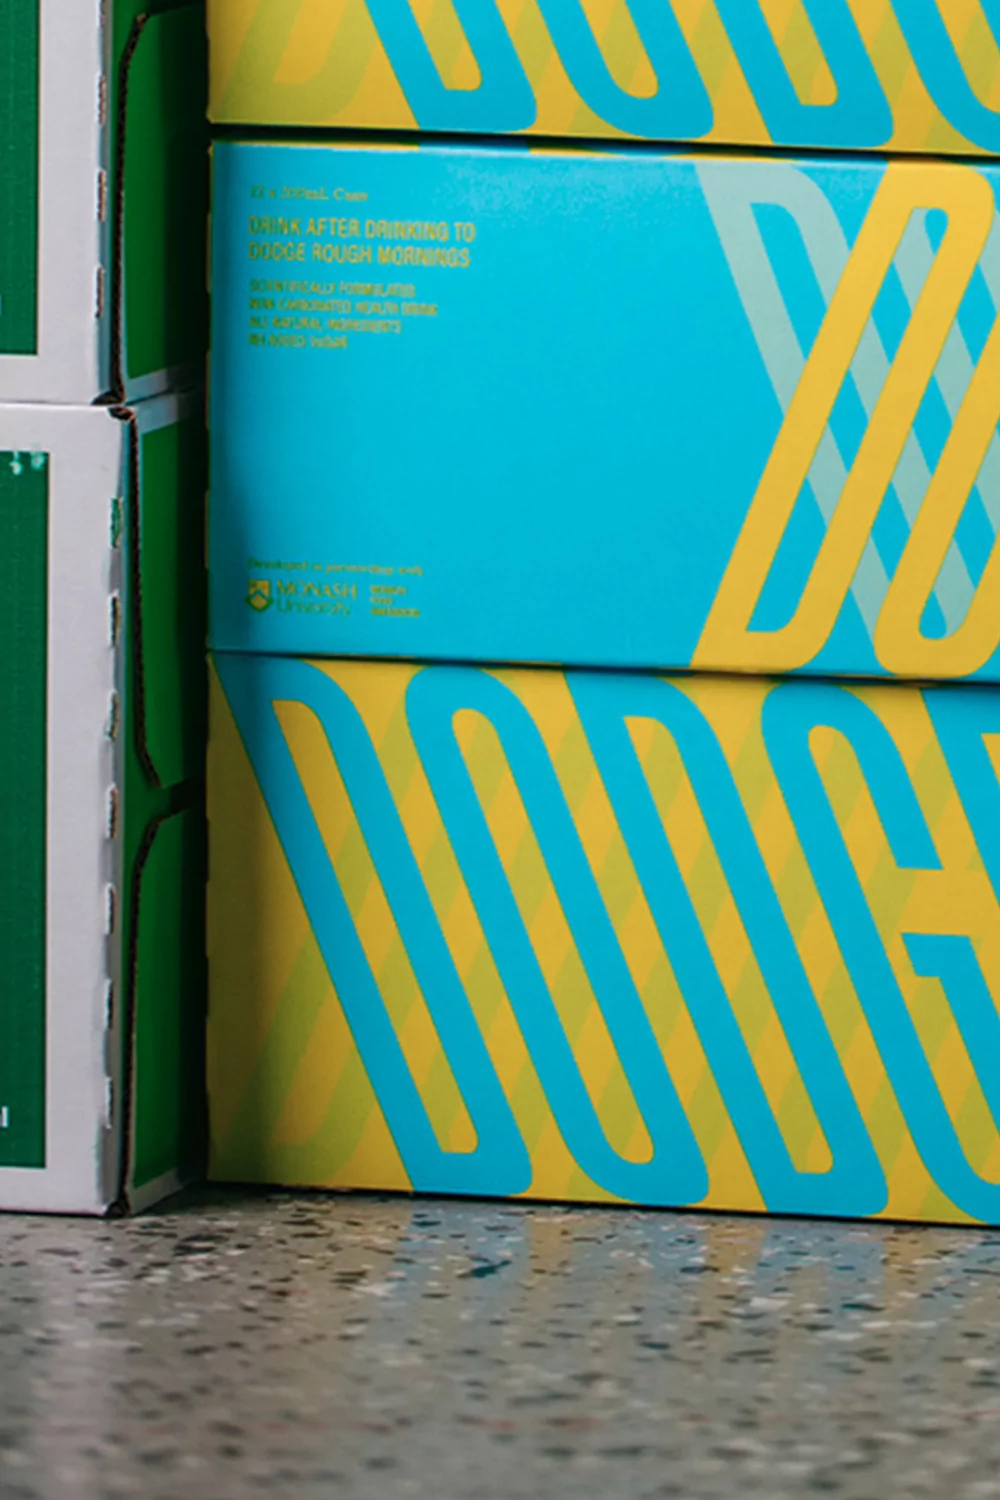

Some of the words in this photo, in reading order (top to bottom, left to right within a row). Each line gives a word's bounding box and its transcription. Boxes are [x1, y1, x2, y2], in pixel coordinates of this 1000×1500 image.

[249, 215, 302, 235] DRINK
[306, 217, 361, 237] AFTER
[365, 219, 449, 242] DRINKING
[454, 222, 476, 242] TO
[249, 242, 306, 261] DODGE
[313, 244, 371, 263] ROUGH
[378, 246, 471, 267] MORNINGS
[277, 580, 357, 599] MONASH
[277, 597, 350, 616] University
